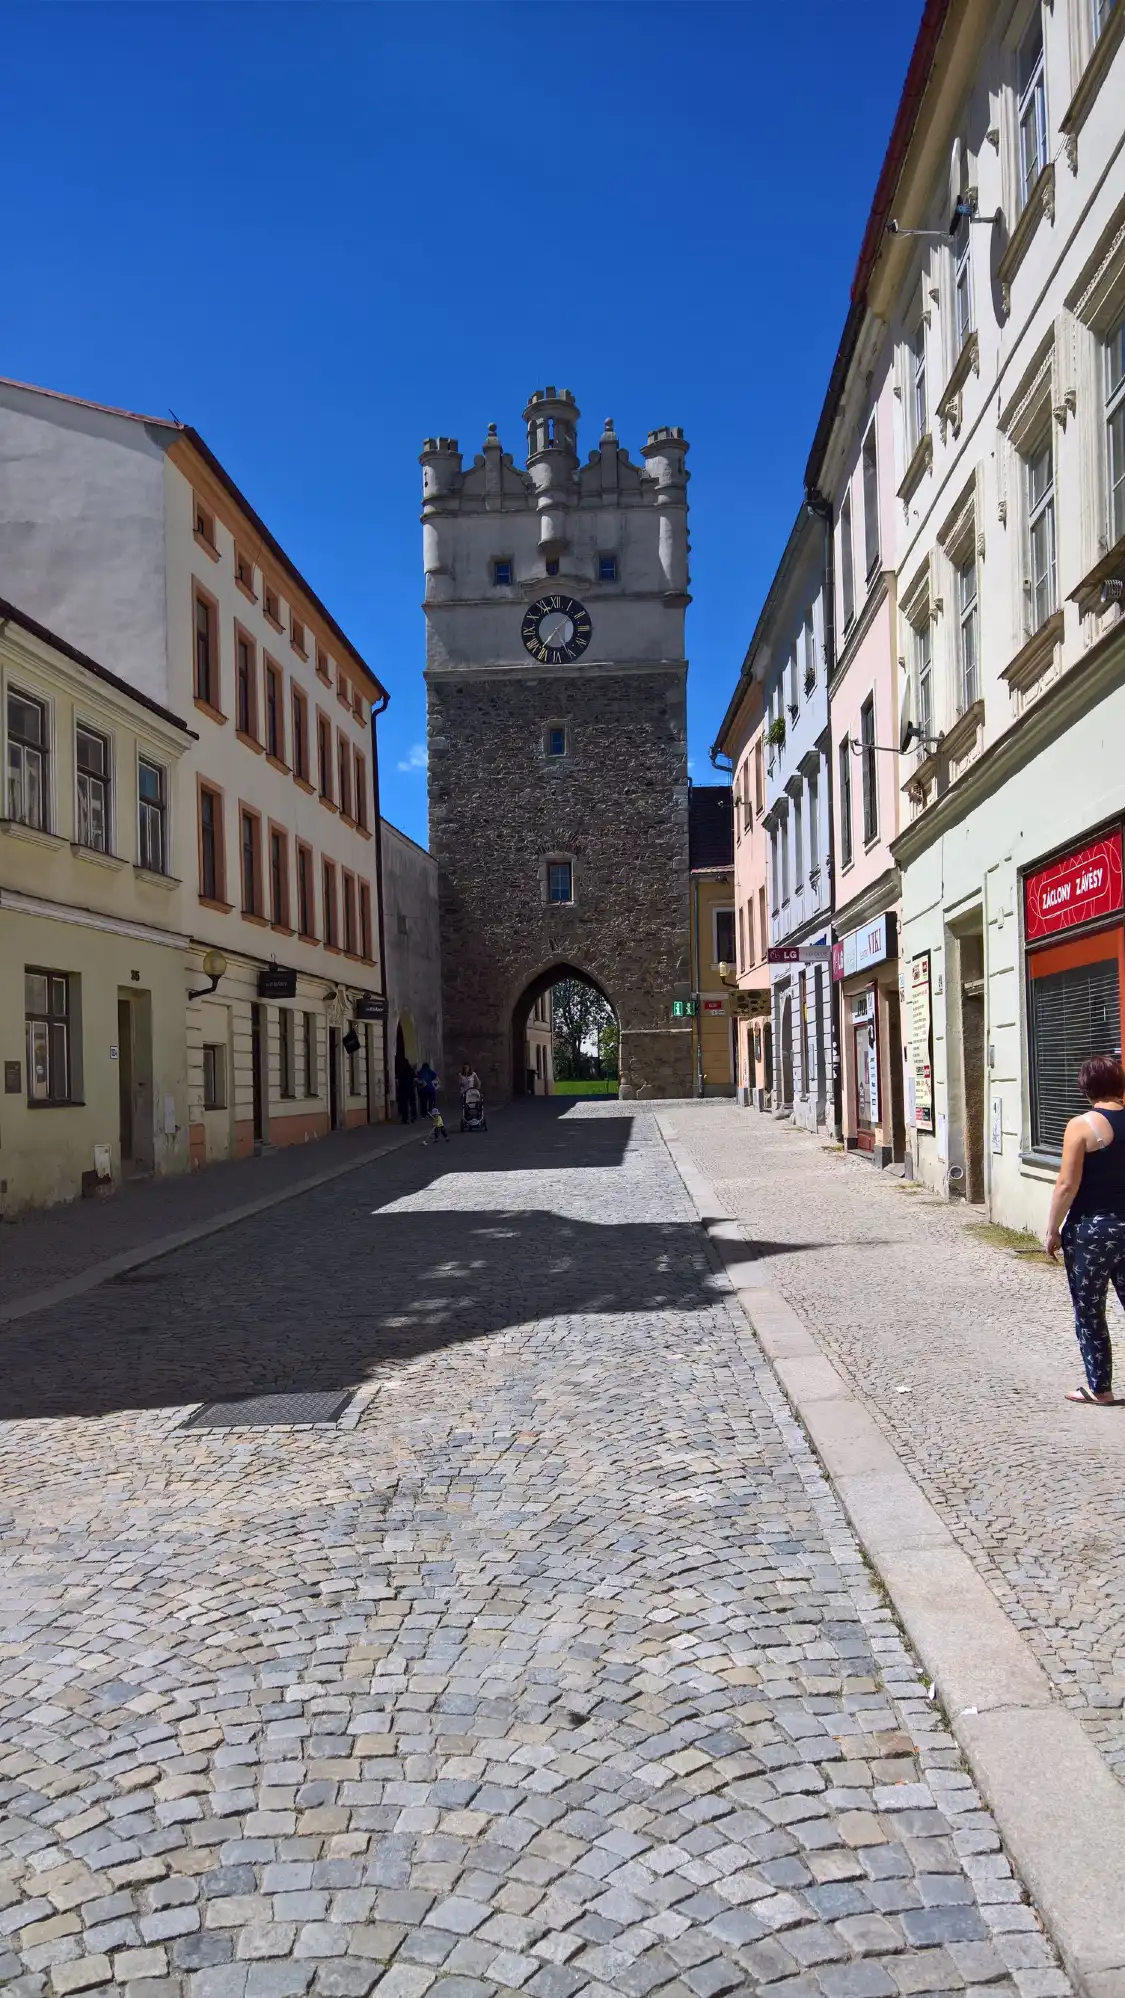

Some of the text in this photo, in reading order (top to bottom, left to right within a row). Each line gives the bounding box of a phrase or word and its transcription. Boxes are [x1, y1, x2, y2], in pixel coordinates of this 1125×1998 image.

[550, 596, 560, 609] XII
[526, 612, 539, 621] X
[574, 610, 586, 619] II
[523, 626, 535, 635] IX
[553, 650, 562, 663] VI
[1042, 867, 1103, 909] ZÁCLONY ZÁVĚSY
[867, 928, 882, 956] VIKI
[783, 951, 797, 959] LG
